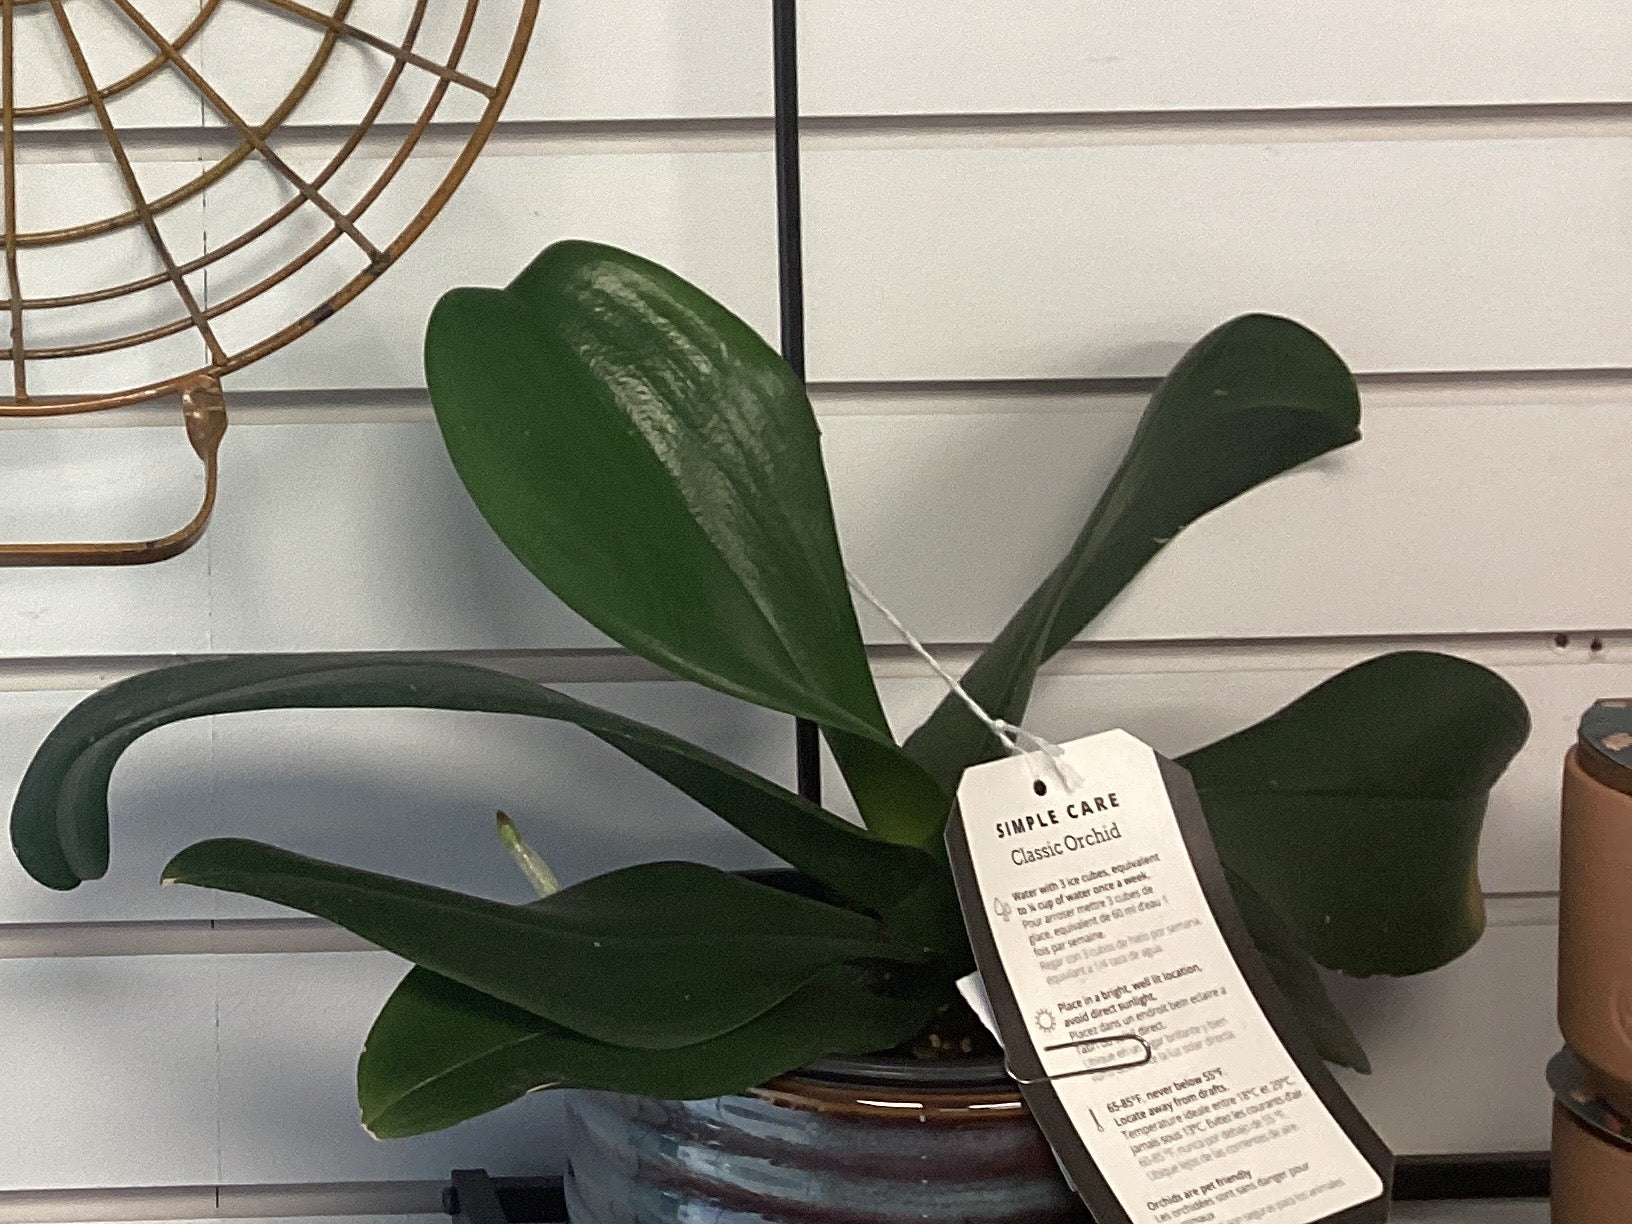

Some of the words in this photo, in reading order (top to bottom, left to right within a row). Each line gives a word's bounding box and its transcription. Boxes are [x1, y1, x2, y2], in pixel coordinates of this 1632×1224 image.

[996, 809, 1059, 839] SIMPLE
[1067, 792, 1120, 819] CARE
[1011, 840, 1063, 866] Classic
[1064, 822, 1122, 852] Orchid
[1012, 887, 1038, 901] Water
[1040, 883, 1059, 894] with
[1061, 879, 1067, 889] 3
[1067, 876, 1080, 887] ice
[1111, 853, 1161, 874] equivalent
[1017, 907, 1027, 916] to
[1038, 900, 1053, 910] cup
[1056, 894, 1065, 905] of
[1066, 888, 1091, 901] water
[1093, 882, 1115, 894] once
[1117, 880, 1122, 888] a
[1022, 918, 1042, 930] Pour
[1045, 909, 1075, 924] arroser
[1142, 885, 1153, 895] de
[1099, 913, 1111, 923] de
[1052, 942, 1065, 954] par
[1058, 999, 1083, 1013] Place
[1084, 995, 1094, 1005] in
[1095, 994, 1101, 1002] a
[1131, 977, 1151, 990] well
[1152, 974, 1162, 984] lit
[1064, 1012, 1090, 1027] avoid
[1091, 1003, 1118, 1019] direct
[1100, 1020, 1122, 1033] dans
[1123, 1015, 1135, 1025] un
[1114, 1110, 1147, 1127] Locate
[1149, 1101, 1174, 1117] away
[1173, 1094, 1197, 1107] from
[1199, 1084, 1229, 1100] drafts.
[1146, 1086, 1174, 1100] never
[1173, 1076, 1202, 1091] below
[1146, 1193, 1184, 1211] Orchids
[1184, 1188, 1199, 1200] are
[1200, 1182, 1217, 1195] pet
[1215, 1169, 1253, 1188] friendly
